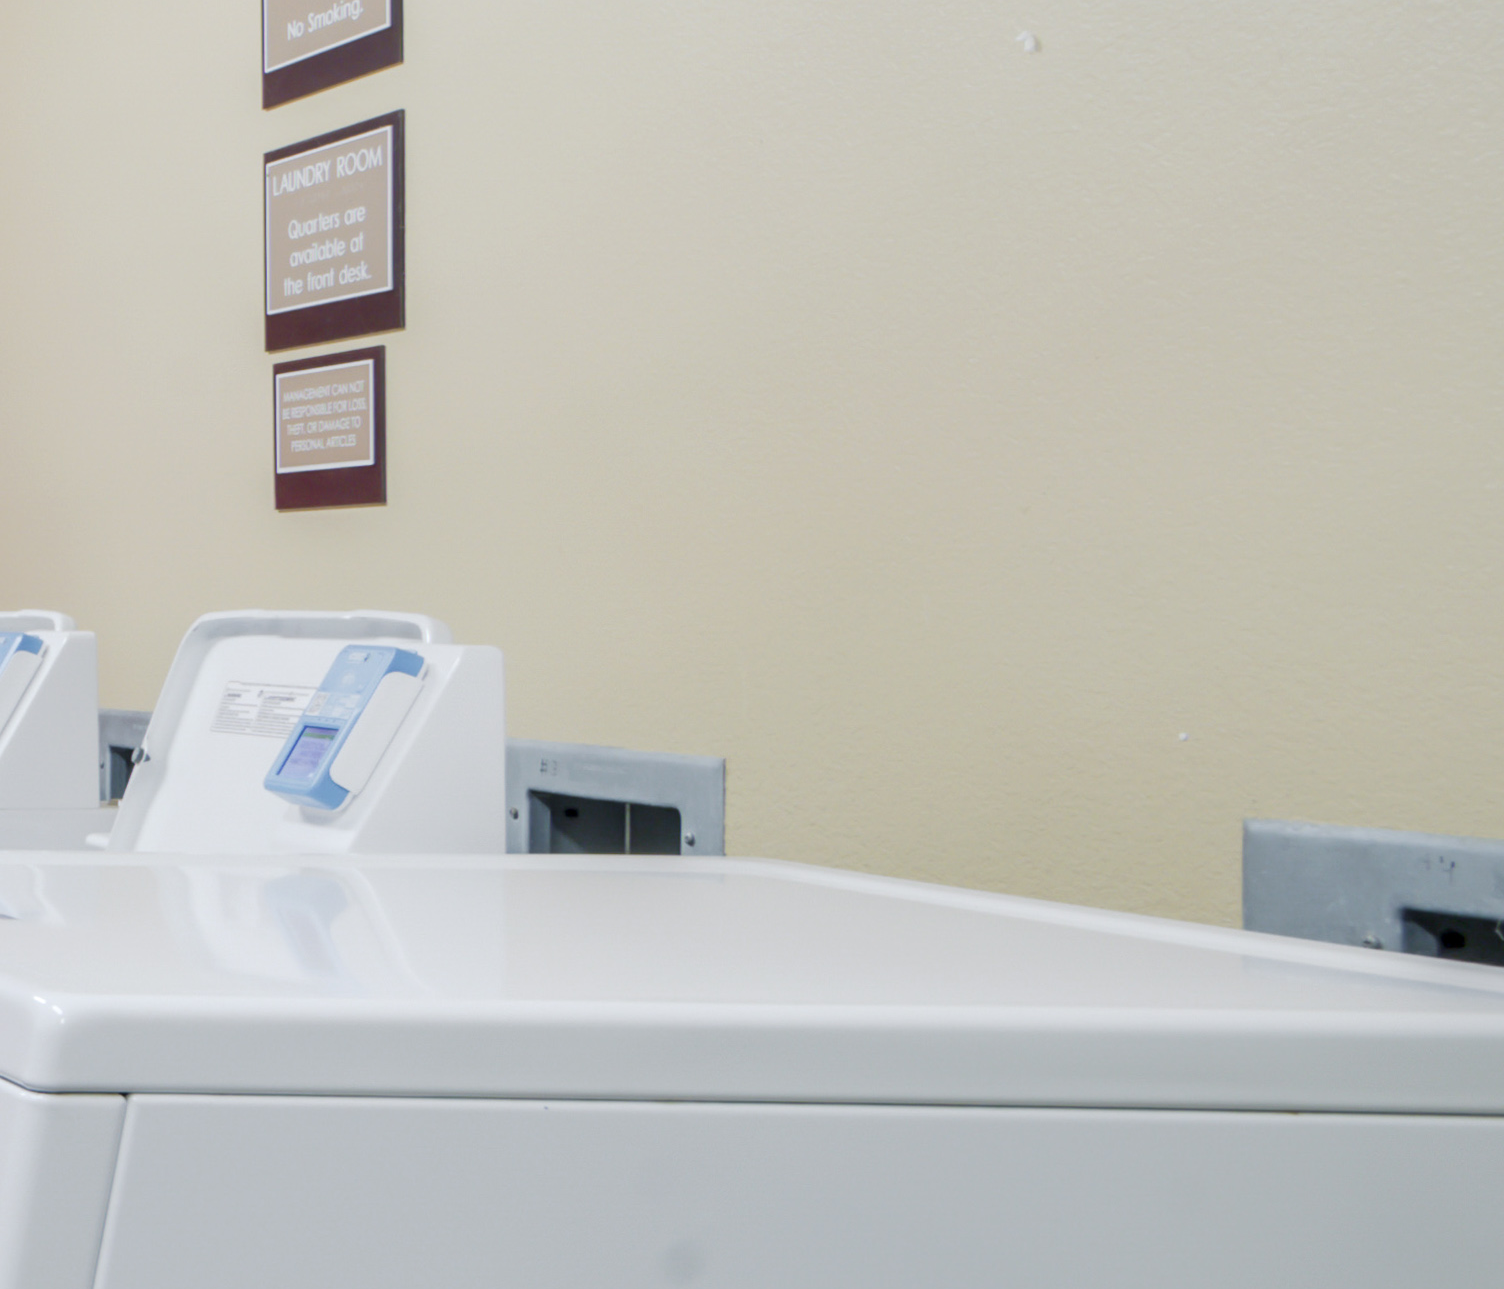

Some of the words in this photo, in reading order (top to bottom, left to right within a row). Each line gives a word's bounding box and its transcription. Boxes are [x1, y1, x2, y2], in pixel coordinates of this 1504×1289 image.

[287, 19, 305, 41] No
[272, 159, 331, 197] LAUNDRY
[336, 145, 384, 179] ROOM
[288, 212, 341, 240] Quarters
[344, 206, 366, 226] are
[289, 237, 346, 267] available
[349, 231, 364, 253] at
[284, 276, 304, 297] the
[307, 267, 335, 292] front
[339, 260, 372, 286] desk.
[283, 385, 330, 402] MANAGEMENT
[349, 380, 365, 393] NOT
